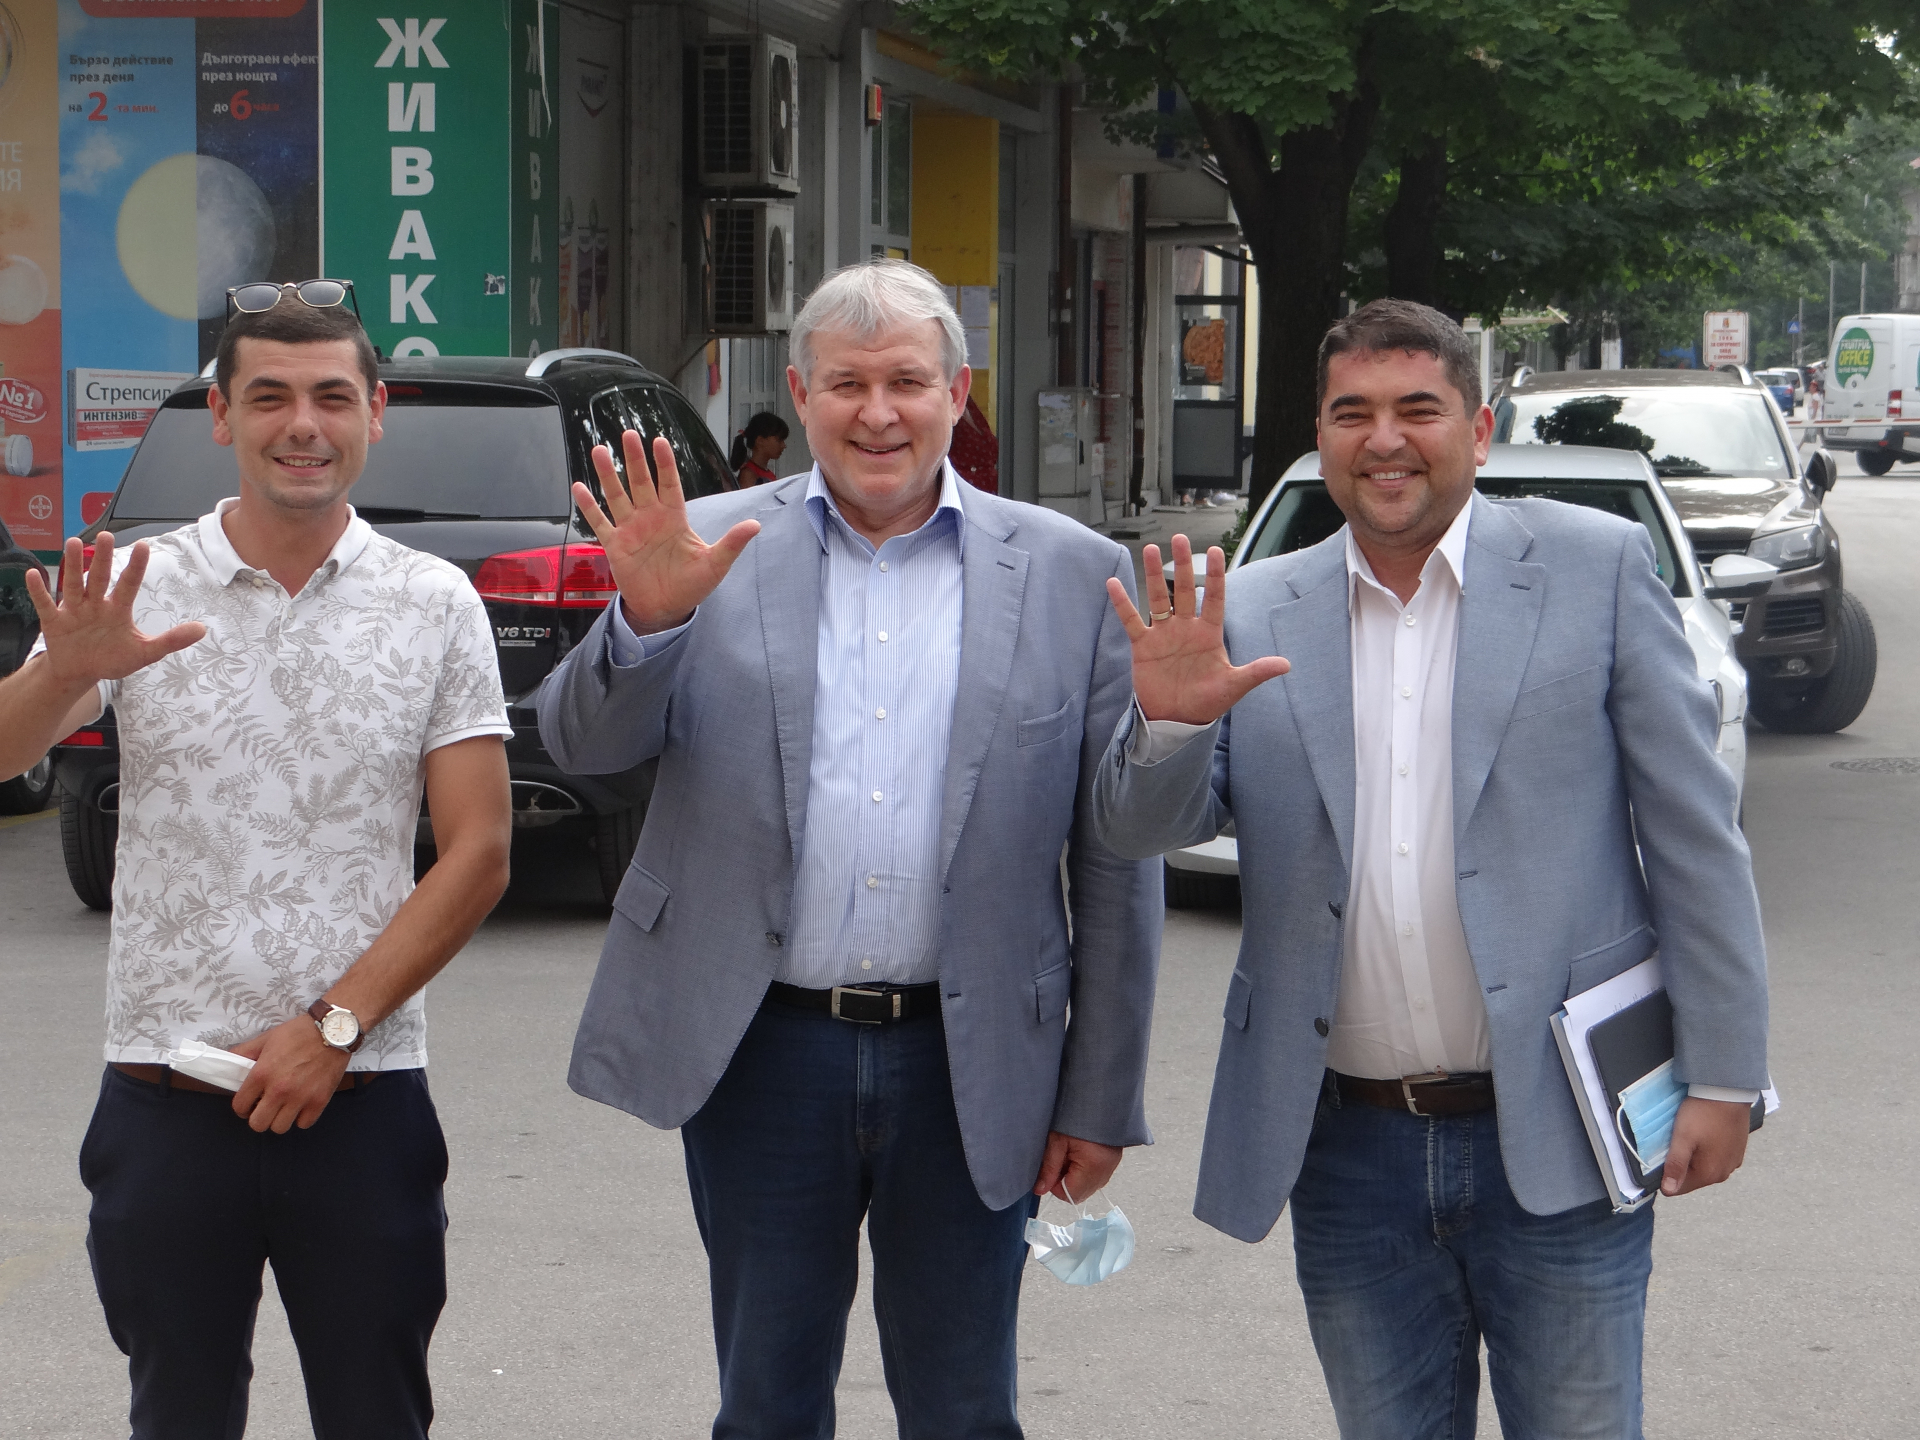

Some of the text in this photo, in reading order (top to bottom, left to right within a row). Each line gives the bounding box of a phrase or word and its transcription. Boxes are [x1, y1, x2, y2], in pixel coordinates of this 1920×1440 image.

[69, 53, 174, 67] Бързо действие
[202, 52, 280, 67] Дълготраен
[69, 72, 135, 84] през деня
[202, 72, 278, 84] през нощта
[68, 104, 83, 113] на
[87, 91, 109, 121] 2
[213, 103, 229, 115] до
[230, 88, 252, 121] 6
[1838, 350, 1871, 366] OFFICE
[83, 410, 138, 422] ИНТЕНЗИВ
[496, 626, 551, 639] V6 TDI
